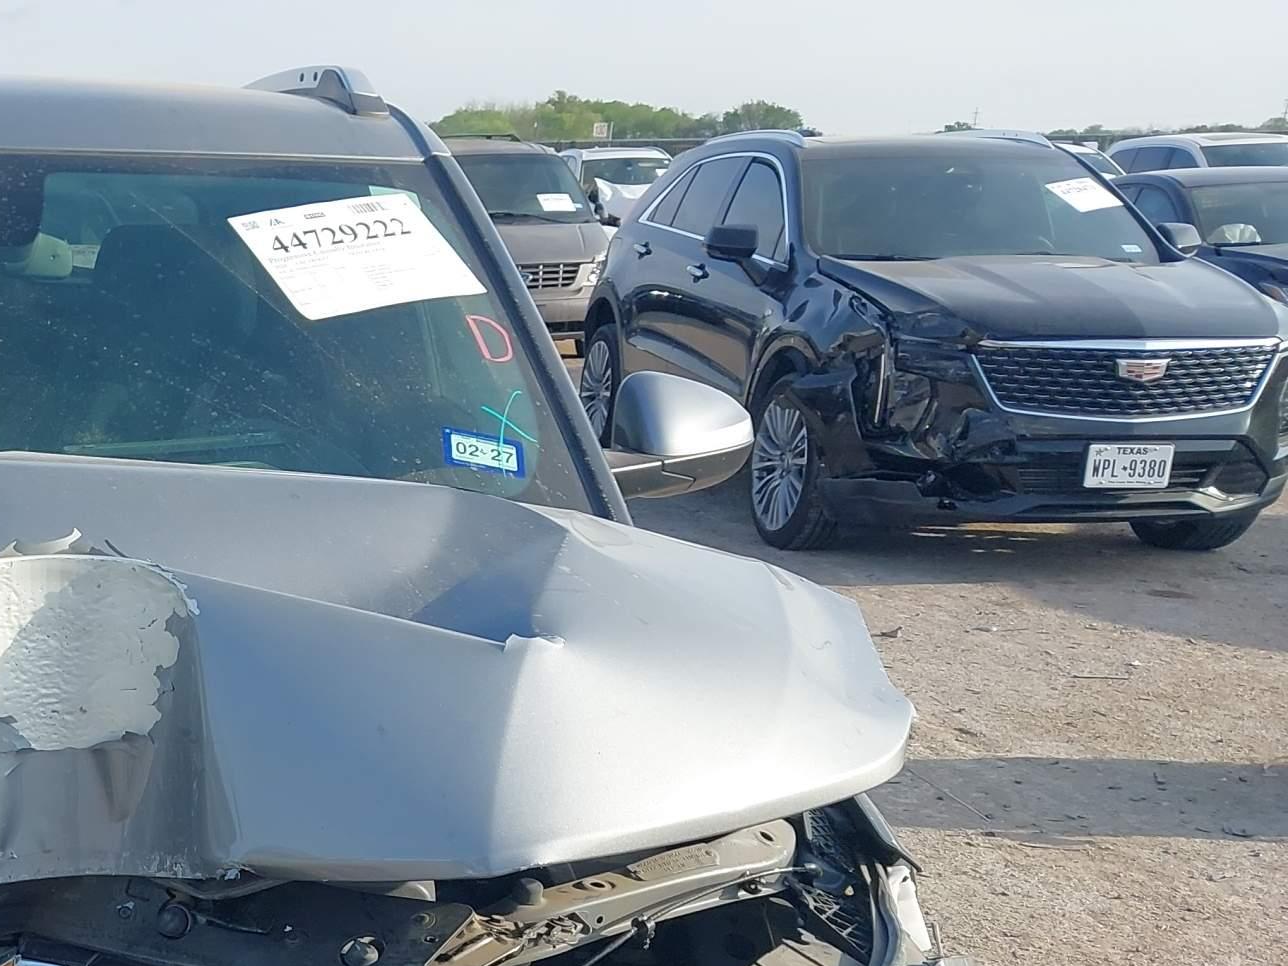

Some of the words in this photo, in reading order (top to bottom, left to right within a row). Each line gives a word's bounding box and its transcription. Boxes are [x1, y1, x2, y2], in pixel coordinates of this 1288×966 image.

[272, 218, 411, 253] 44729222
[465, 314, 513, 362] D
[1116, 446, 1149, 456] TEXAS
[1128, 459, 1167, 478] 9380
